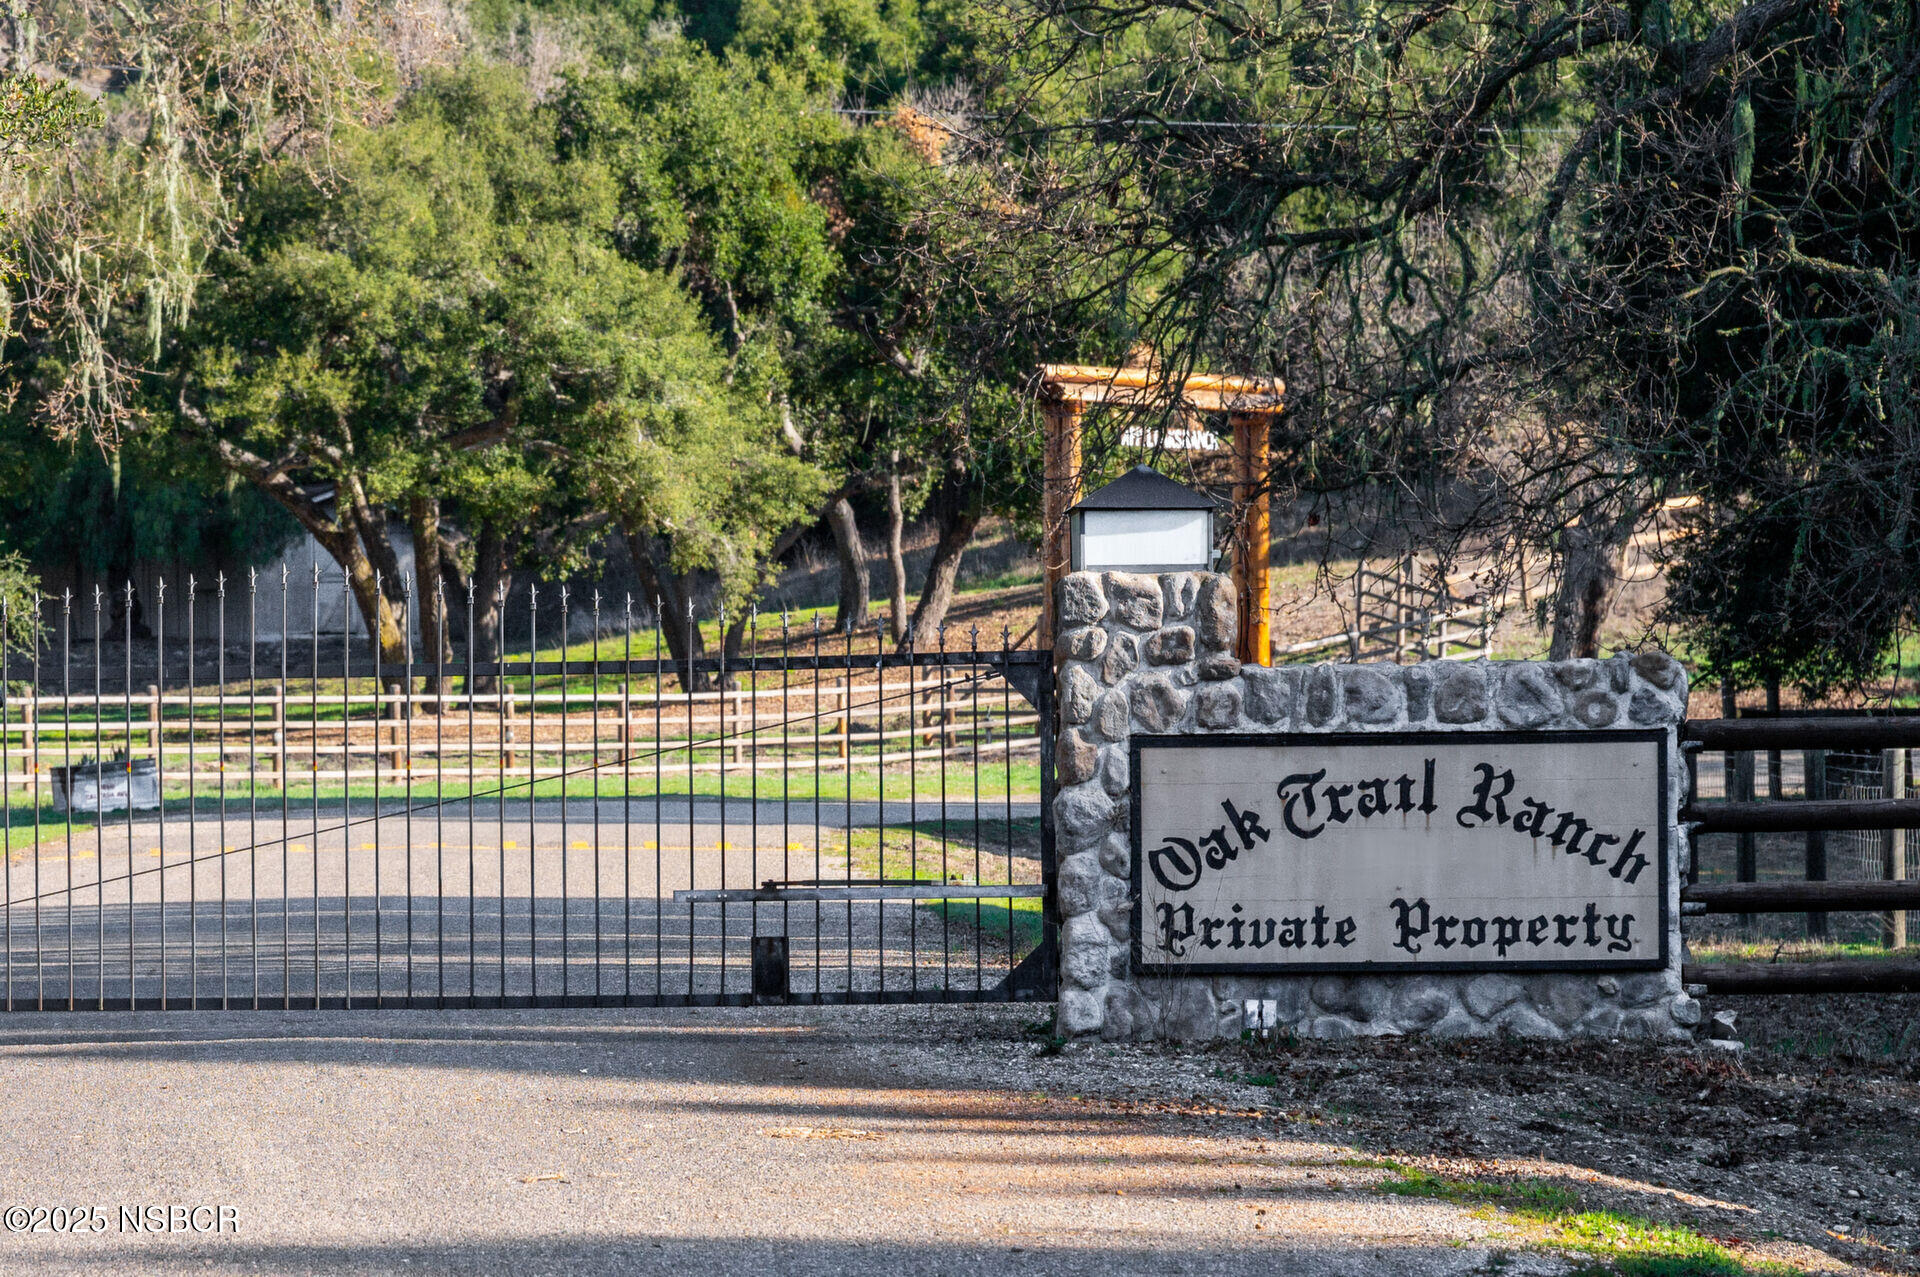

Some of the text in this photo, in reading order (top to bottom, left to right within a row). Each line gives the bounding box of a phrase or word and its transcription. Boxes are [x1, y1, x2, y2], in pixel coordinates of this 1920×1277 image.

[1149, 758, 1650, 891] Oak Trail Ranch
[1156, 898, 1635, 957] Private Property
